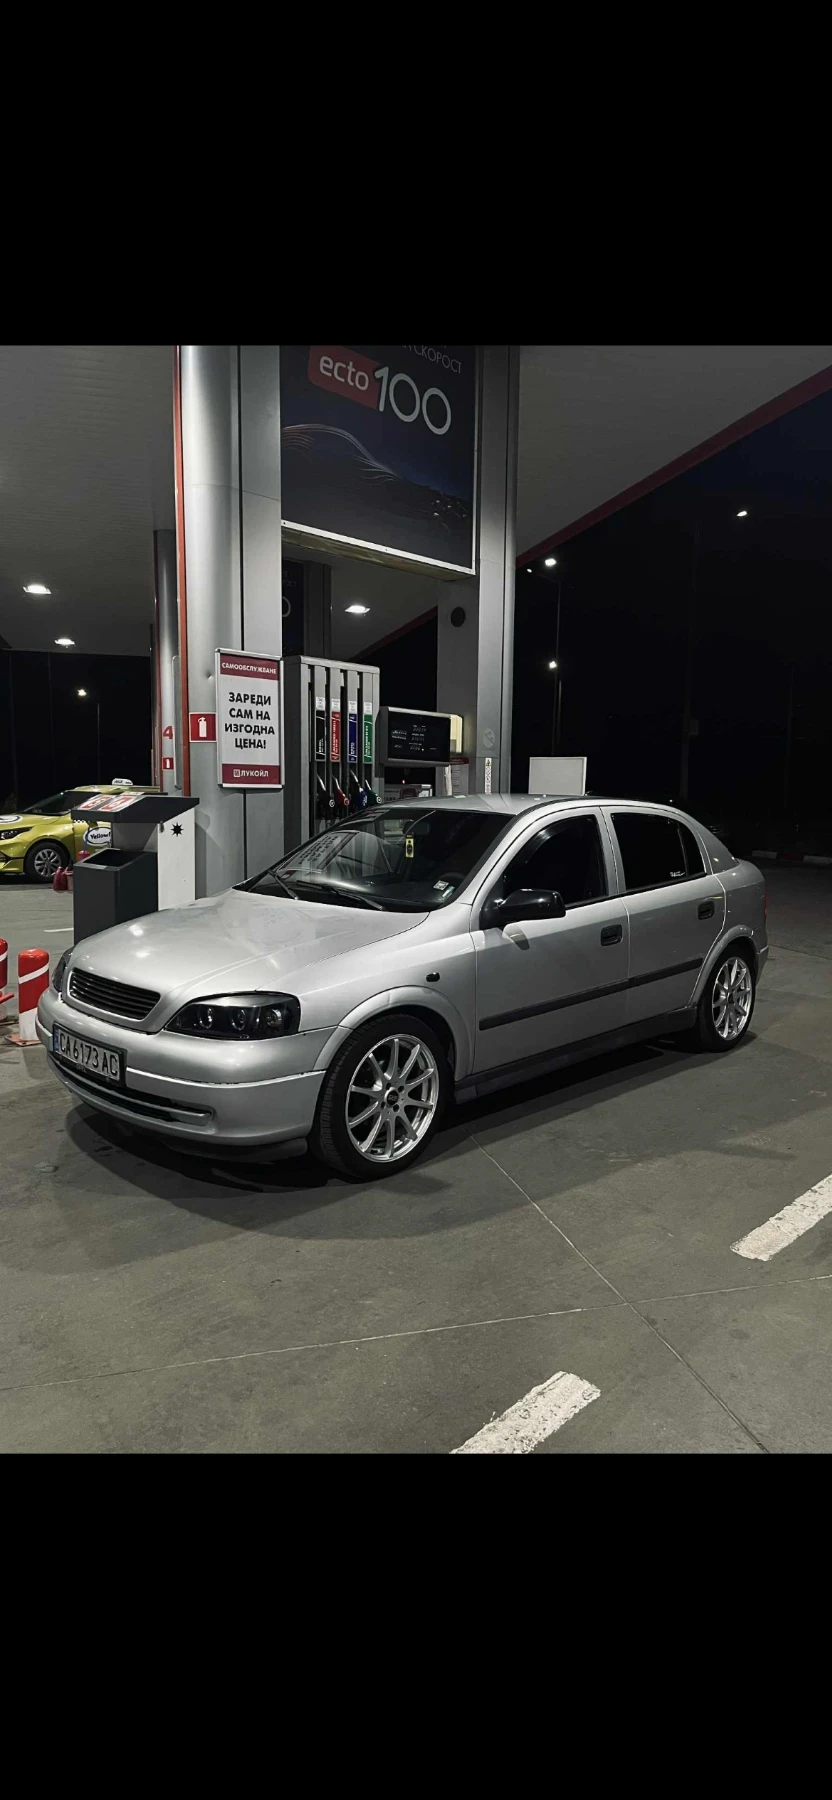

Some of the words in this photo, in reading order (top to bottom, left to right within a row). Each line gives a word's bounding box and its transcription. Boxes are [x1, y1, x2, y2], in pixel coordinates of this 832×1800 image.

[319, 355, 370, 391] ecto
[374, 366, 452, 435] 100
[221, 662, 277, 675] САМООБСЛУЖВАНЕ
[228, 692, 271, 706] ЗАРЕДИ
[229, 708, 253, 720] САМ
[256, 710, 271, 721] НА
[163, 725, 173, 740] 4
[224, 723, 275, 735] ИЗГОДНА
[235, 738, 267, 750] ЦЕНА!
[240, 769, 269, 777] ЛУКОЙЛ
[60, 1033, 71, 1057] CA
[73, 1040, 99, 1069] 6173
[102, 1052, 118, 1076] AC
